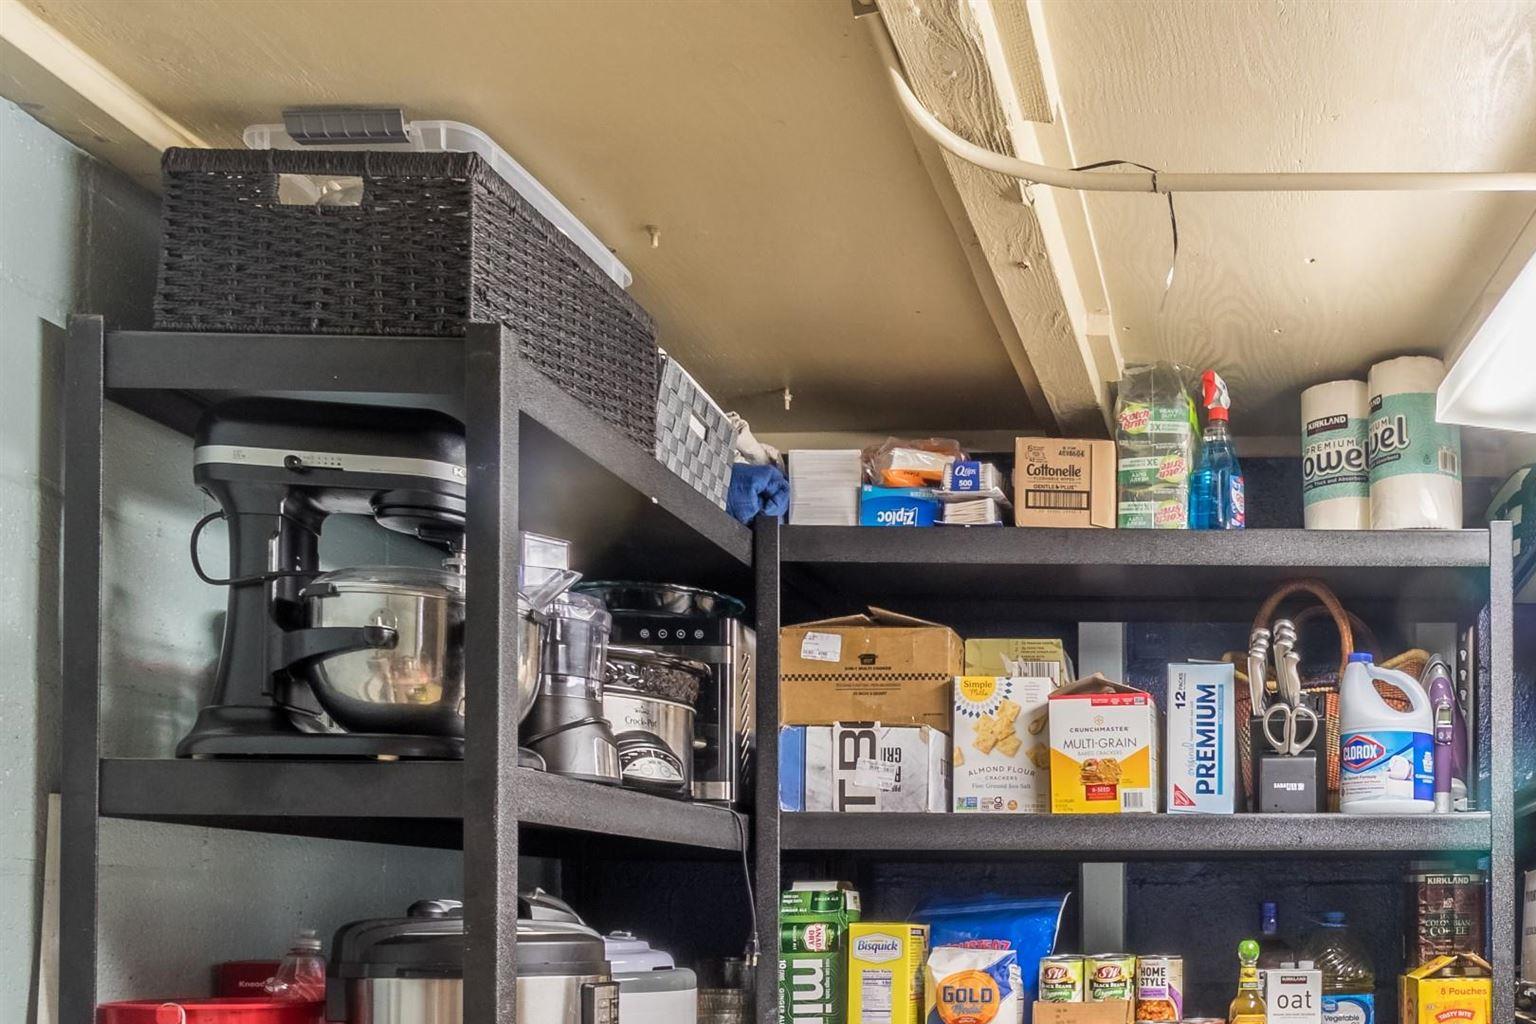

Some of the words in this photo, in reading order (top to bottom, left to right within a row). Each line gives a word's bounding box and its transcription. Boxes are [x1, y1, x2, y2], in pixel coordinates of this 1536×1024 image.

[1308, 415, 1346, 430] KIRKLAND
[1306, 439, 1357, 455] PREMIUM
[1027, 464, 1081, 477] Cottonelle
[959, 479, 973, 487] 500
[877, 506, 914, 525] Ziploc
[963, 680, 992, 691] Simple
[1175, 691, 1186, 710] 12
[1195, 684, 1216, 795] PREMIUM
[1343, 744, 1377, 761] CLOROX
[968, 765, 1005, 776] ALMOND
[1007, 766, 1035, 776] FLOUR
[1427, 877, 1469, 885] KIRKLAND
[857, 940, 898, 953] Bisquick
[779, 959, 786, 969] 10
[1141, 967, 1166, 977] HOME
[1140, 978, 1166, 987] STYLE
[943, 985, 992, 1003] GOLD
[1277, 991, 1312, 1009] oat
[1324, 1014, 1360, 1023] Vegetable
[1438, 1011, 1458, 1020] TASTY
